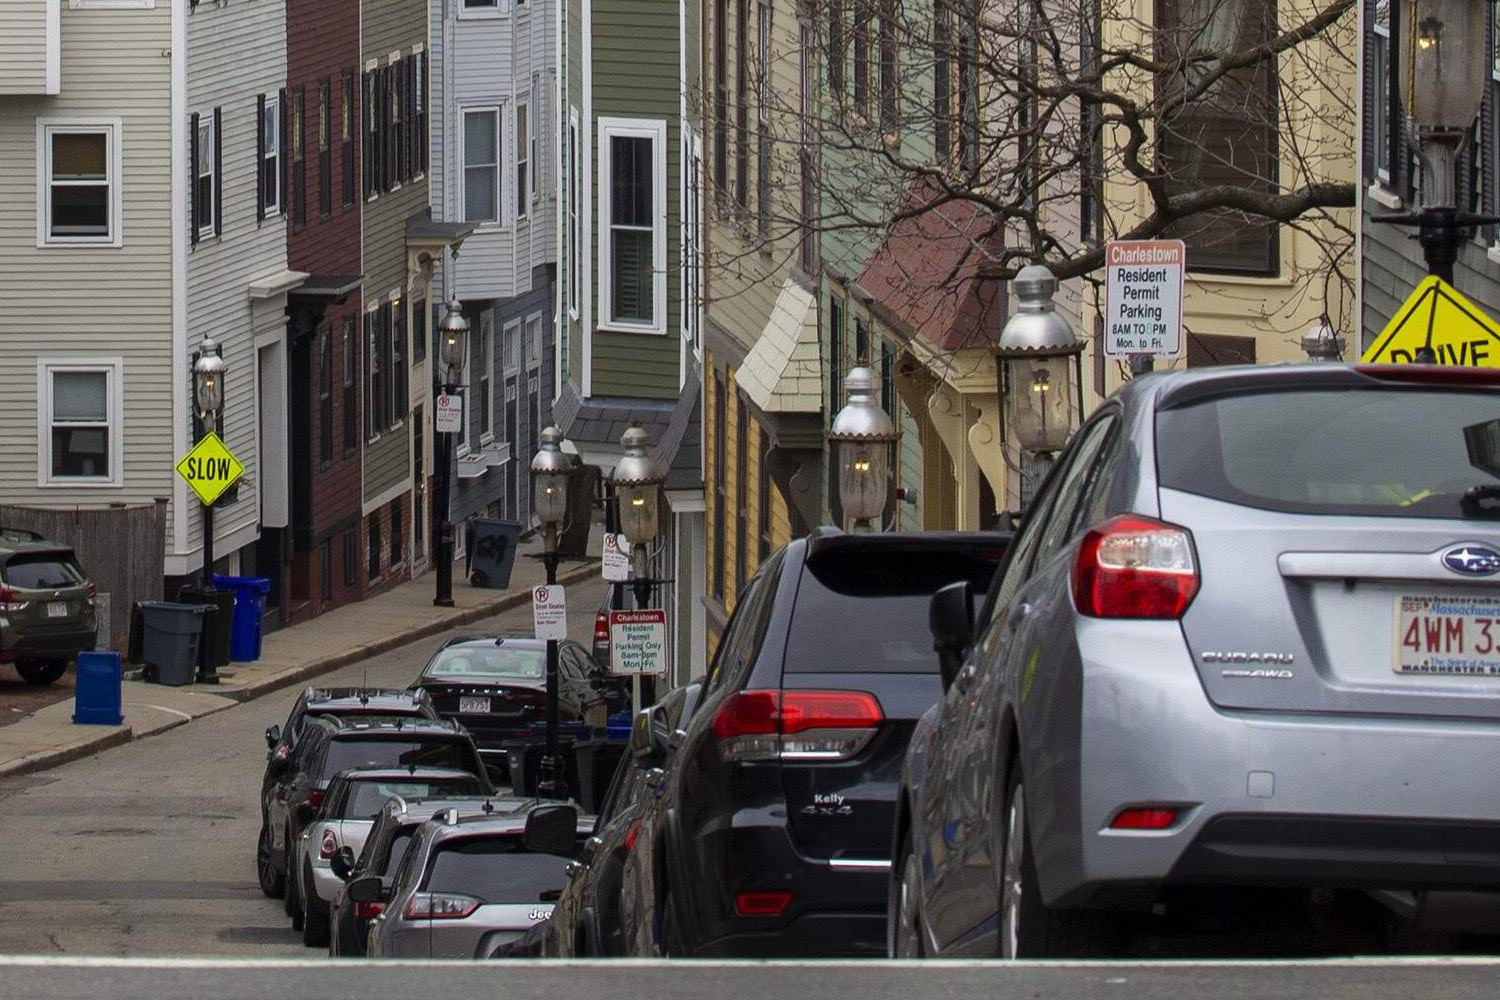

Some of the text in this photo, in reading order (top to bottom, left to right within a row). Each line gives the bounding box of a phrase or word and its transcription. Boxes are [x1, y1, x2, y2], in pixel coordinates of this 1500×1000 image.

[1111, 245, 1179, 263] Charlestown
[1117, 268, 1167, 282] Resident
[1123, 286, 1160, 300] Permit
[1120, 304, 1162, 321] Parking
[1112, 324, 1131, 335] 8AM
[1139, 338, 1147, 348] to
[187, 457, 231, 480] SLOW
[617, 614, 659, 622] Charlestown
[1404, 617, 1463, 652] 4WM
[645, 642, 661, 650] Only
[1202, 652, 1294, 663] SUBARU
[1250, 670, 1293, 679] AWD
[814, 794, 845, 805] Kelly
[529, 909, 552, 920] Jee
